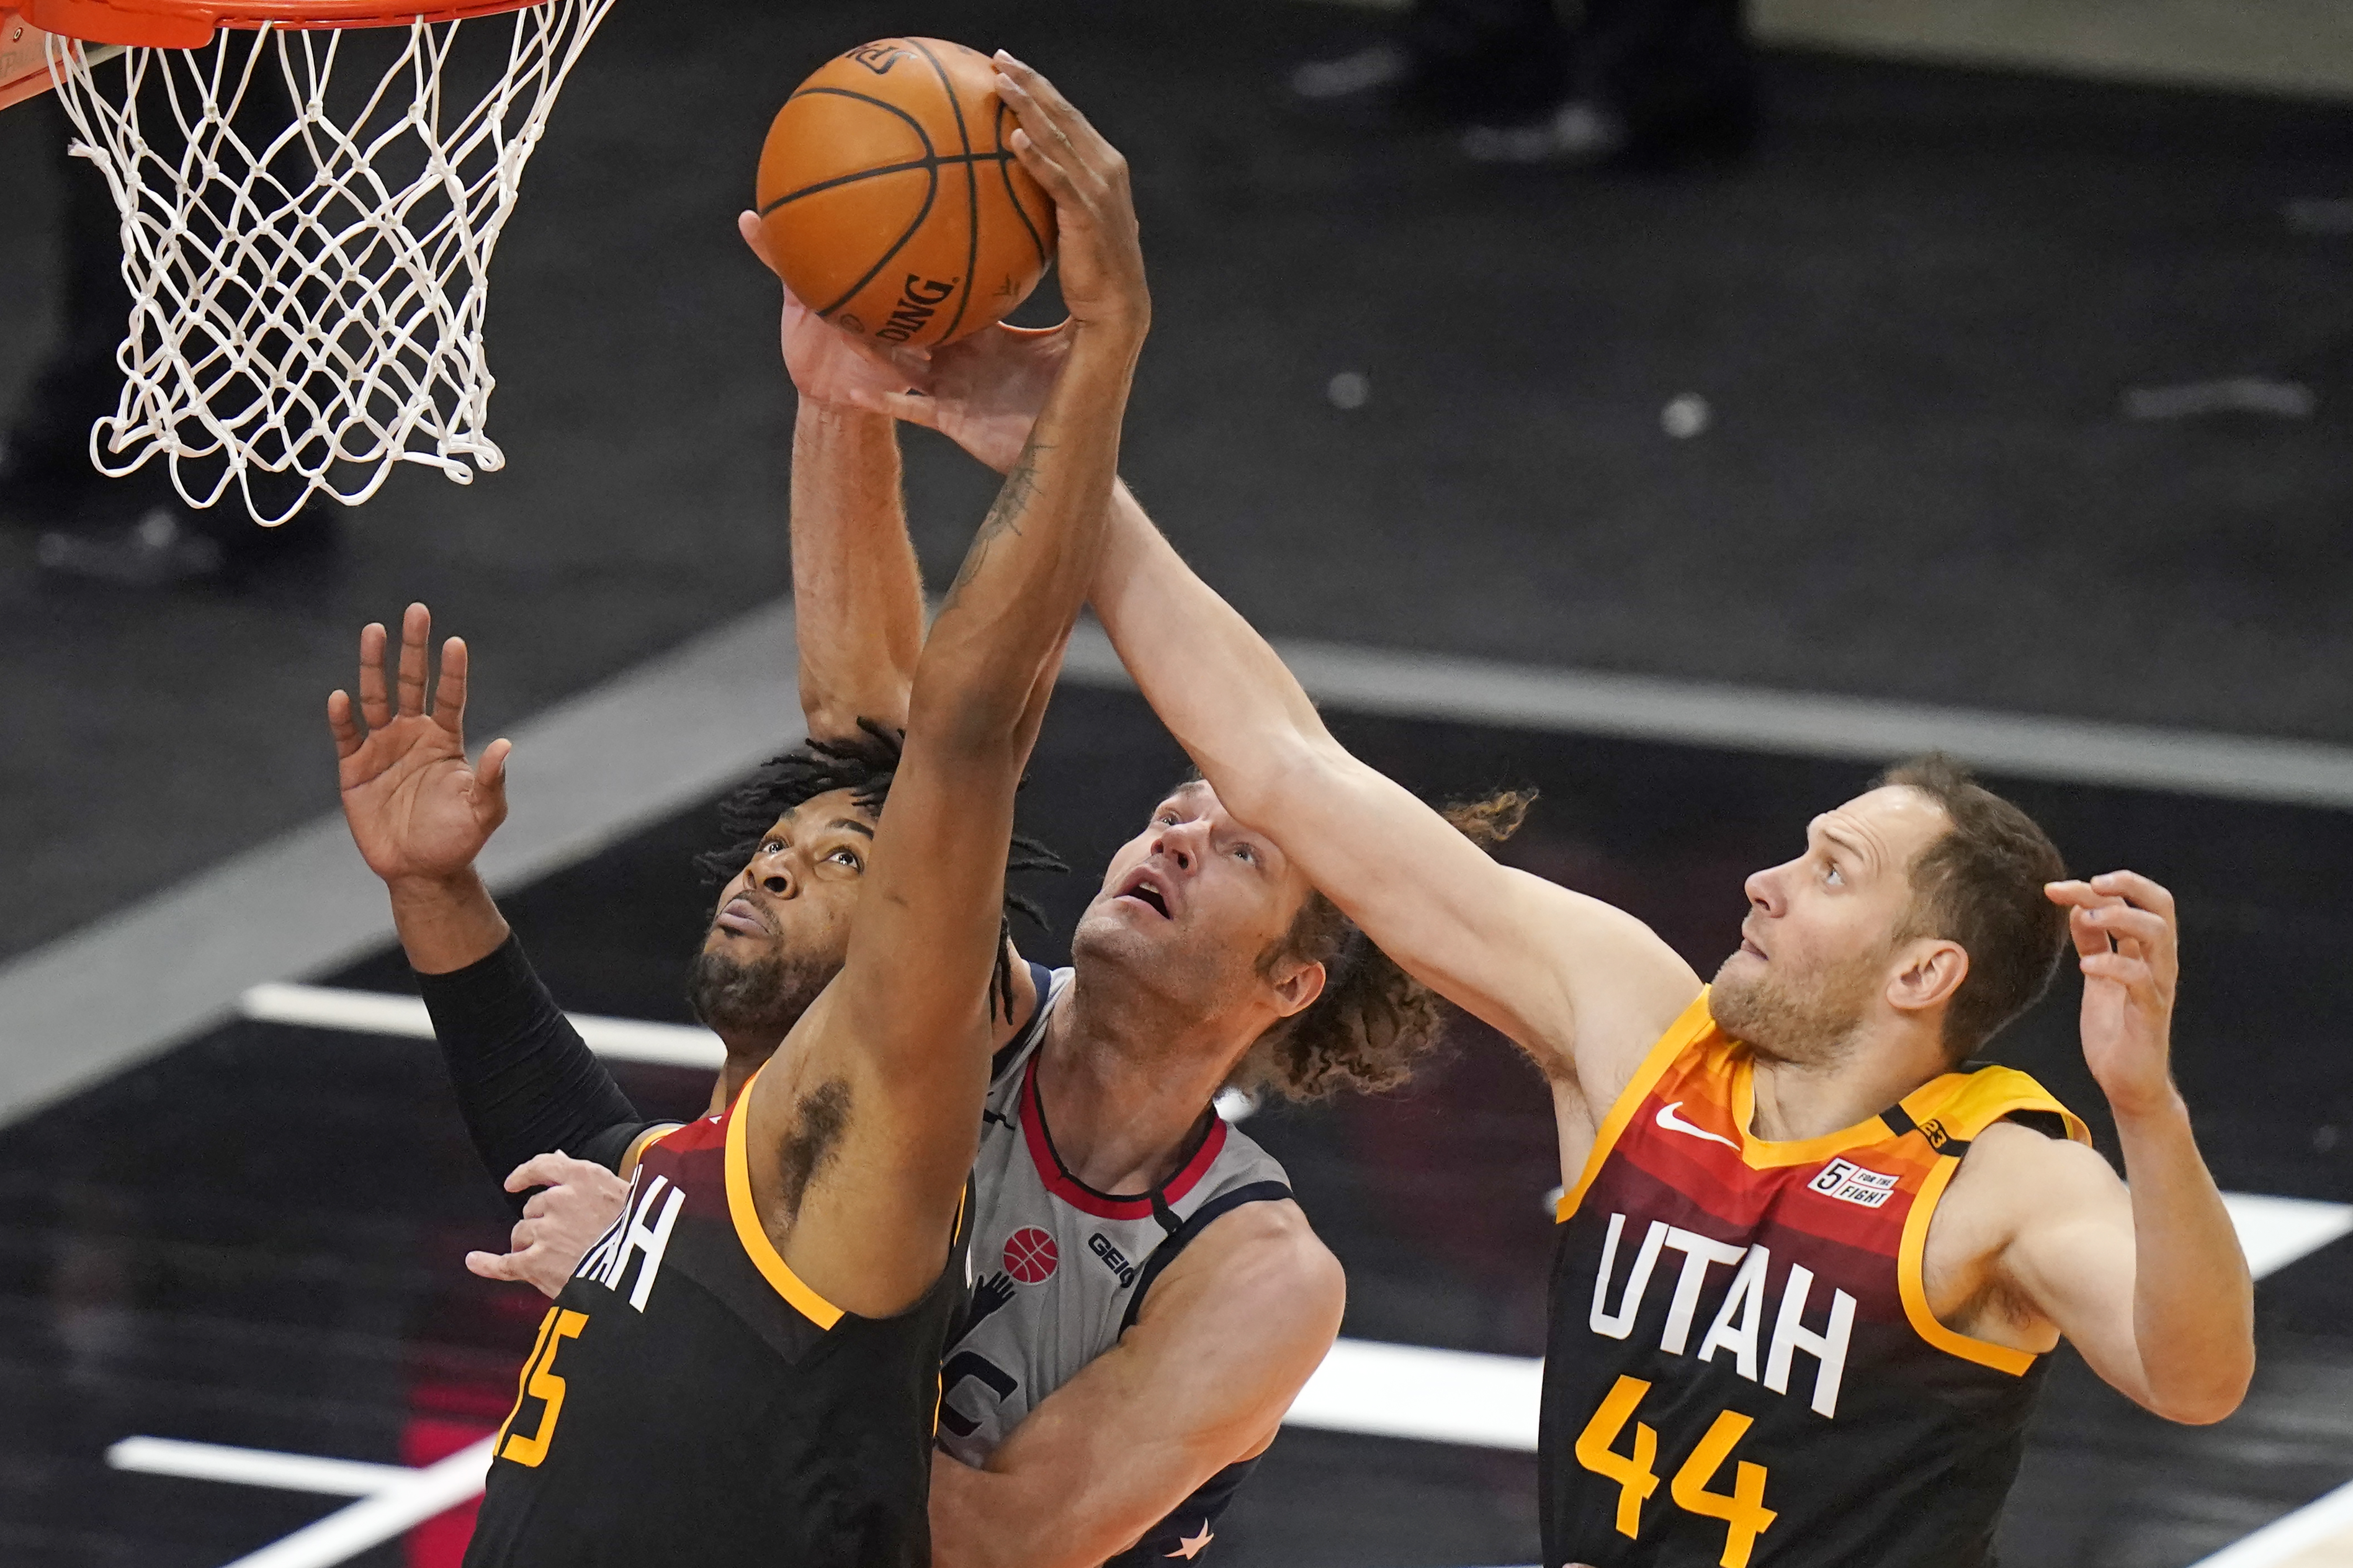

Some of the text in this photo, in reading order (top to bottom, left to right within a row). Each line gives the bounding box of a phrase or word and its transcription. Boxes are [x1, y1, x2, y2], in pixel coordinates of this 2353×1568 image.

[1817, 1163, 1851, 1189] 5
[1858, 1173, 1893, 1186] FOR THE
[1839, 1185, 1887, 1204] FIGHT
[1589, 1212, 1858, 1419] UTAH
[1575, 1374, 1778, 1568] 44
